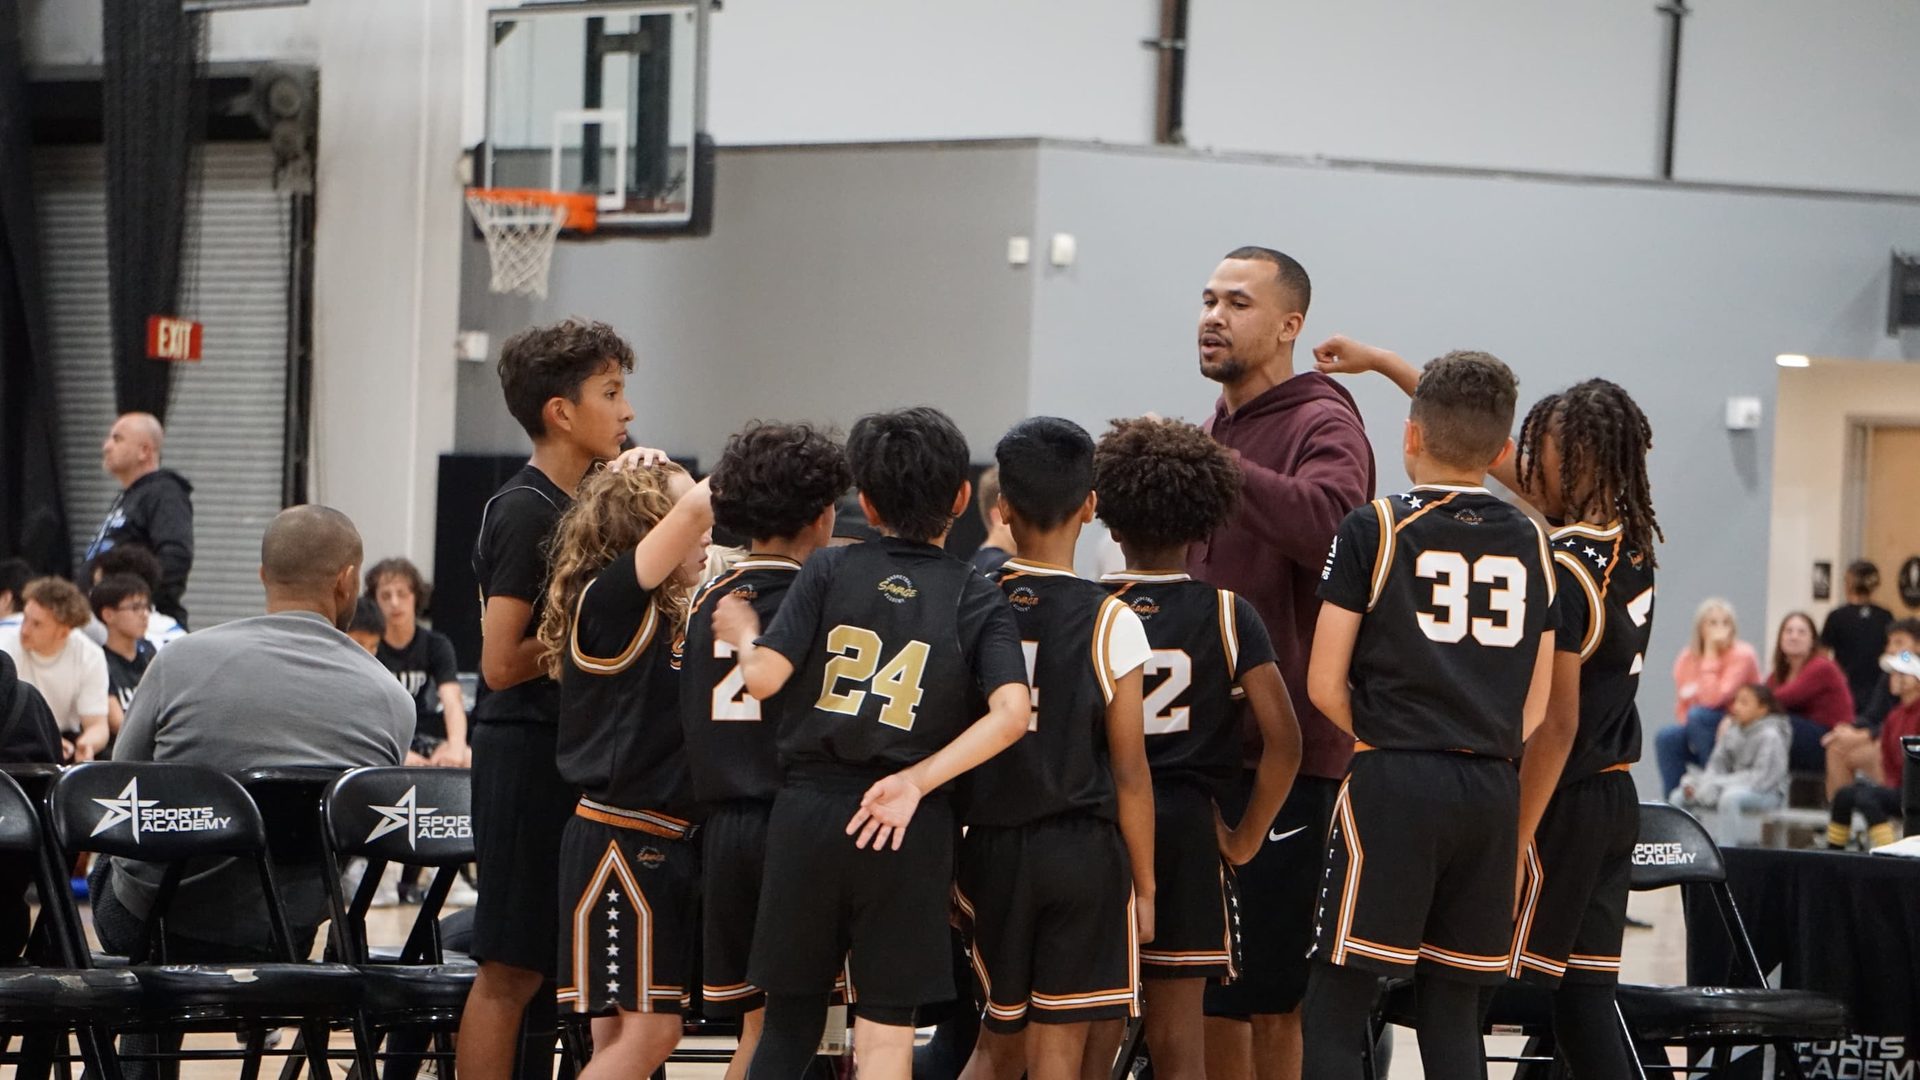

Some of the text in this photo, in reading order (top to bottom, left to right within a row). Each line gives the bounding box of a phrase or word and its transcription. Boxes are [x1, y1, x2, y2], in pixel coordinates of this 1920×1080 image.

[158, 318, 191, 359] EXIT
[1415, 549, 1527, 648] 33
[814, 624, 931, 732] 24
[141, 807, 214, 820] SPORTS
[140, 817, 231, 832] ACADEMY
[418, 815, 471, 827] SPOR
[417, 827, 473, 839] ACAD
[1632, 843, 1683, 854] PORTS
